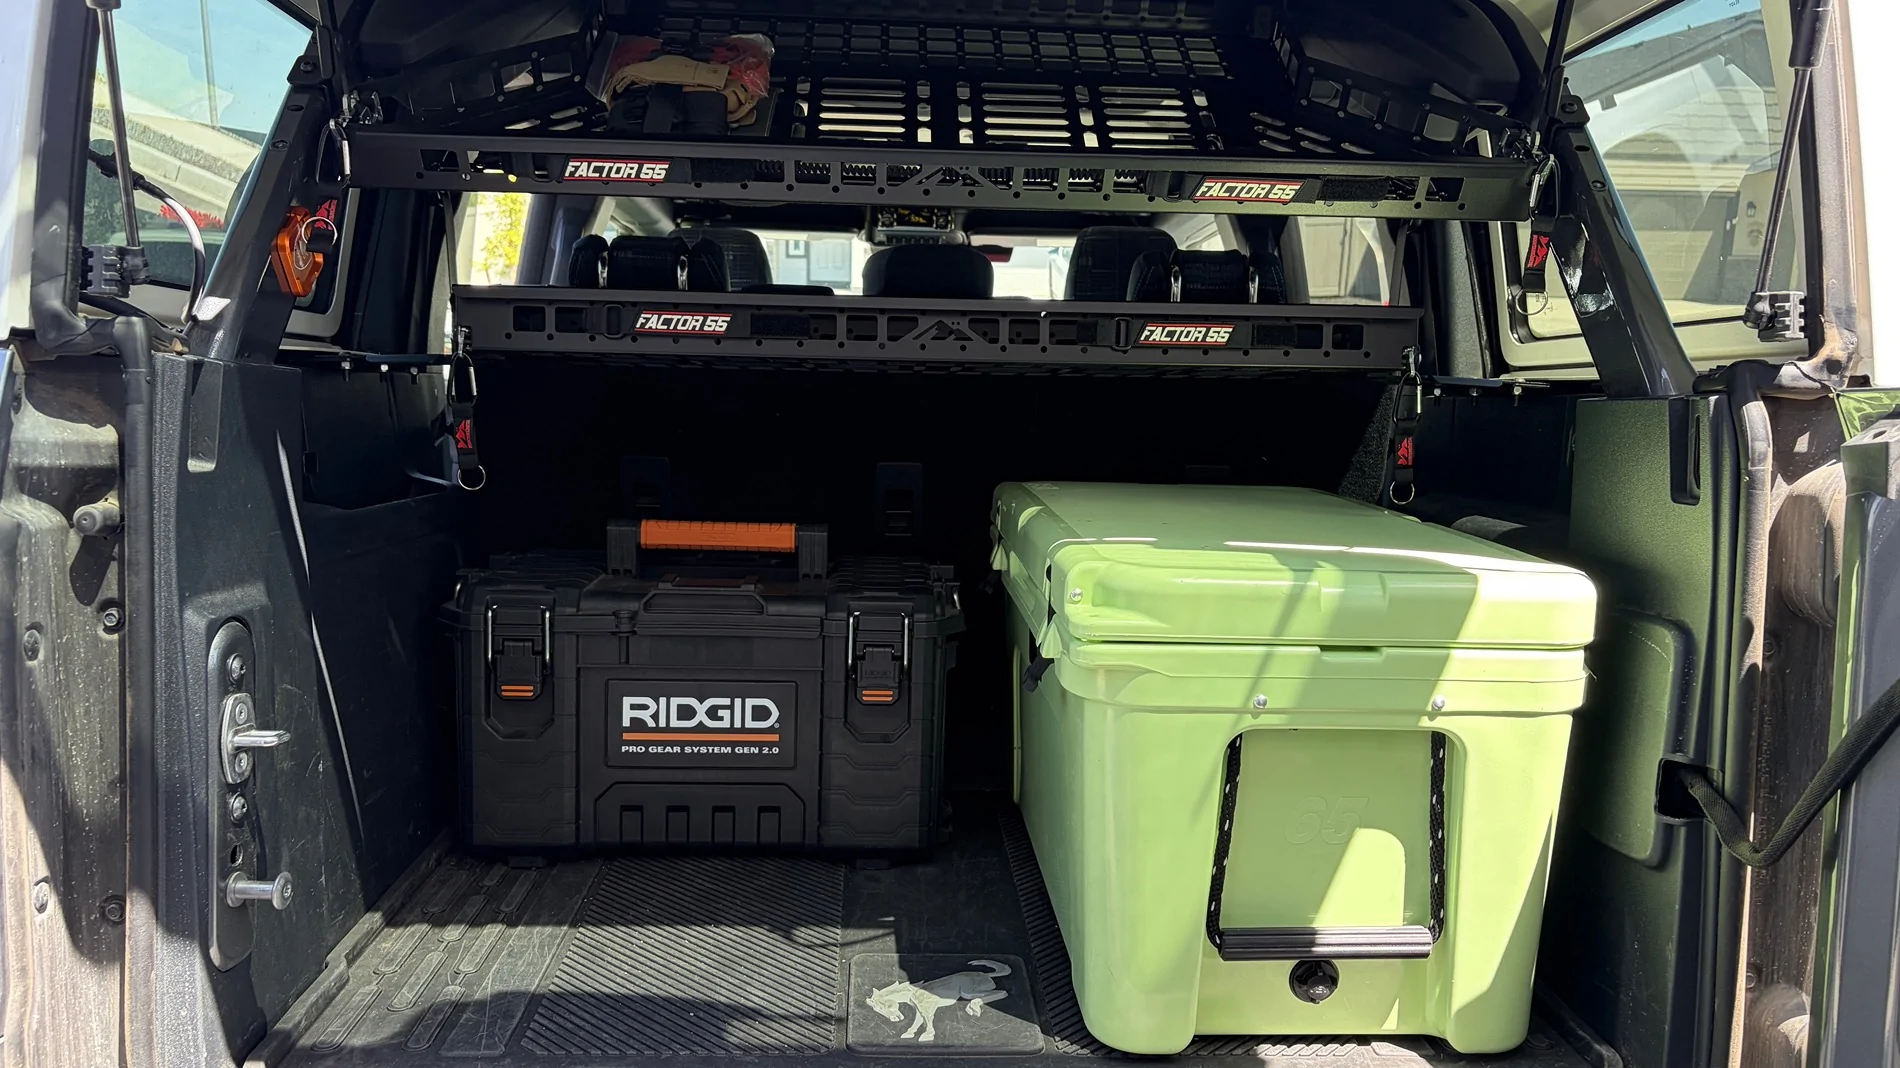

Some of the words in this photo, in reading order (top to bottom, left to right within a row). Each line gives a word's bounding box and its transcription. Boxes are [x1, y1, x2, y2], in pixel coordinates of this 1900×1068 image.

[564, 161, 639, 178] FACTOR
[639, 163, 669, 179] 55
[1195, 182, 1271, 198] FACTOR
[1268, 184, 1301, 199] 55
[635, 313, 704, 331] FACTOR
[703, 315, 731, 332] 55
[1140, 326, 1206, 342] FACTOR
[1205, 327, 1233, 343] 55
[622, 696, 780, 728] RIDGID
[621, 745, 646, 753] PRO
[648, 745, 682, 754] GEAR
[684, 745, 732, 754] SYSTEM
[734, 746, 759, 754] GEN
[762, 746, 779, 754] 2.0
[1284, 795, 1370, 845] 65
